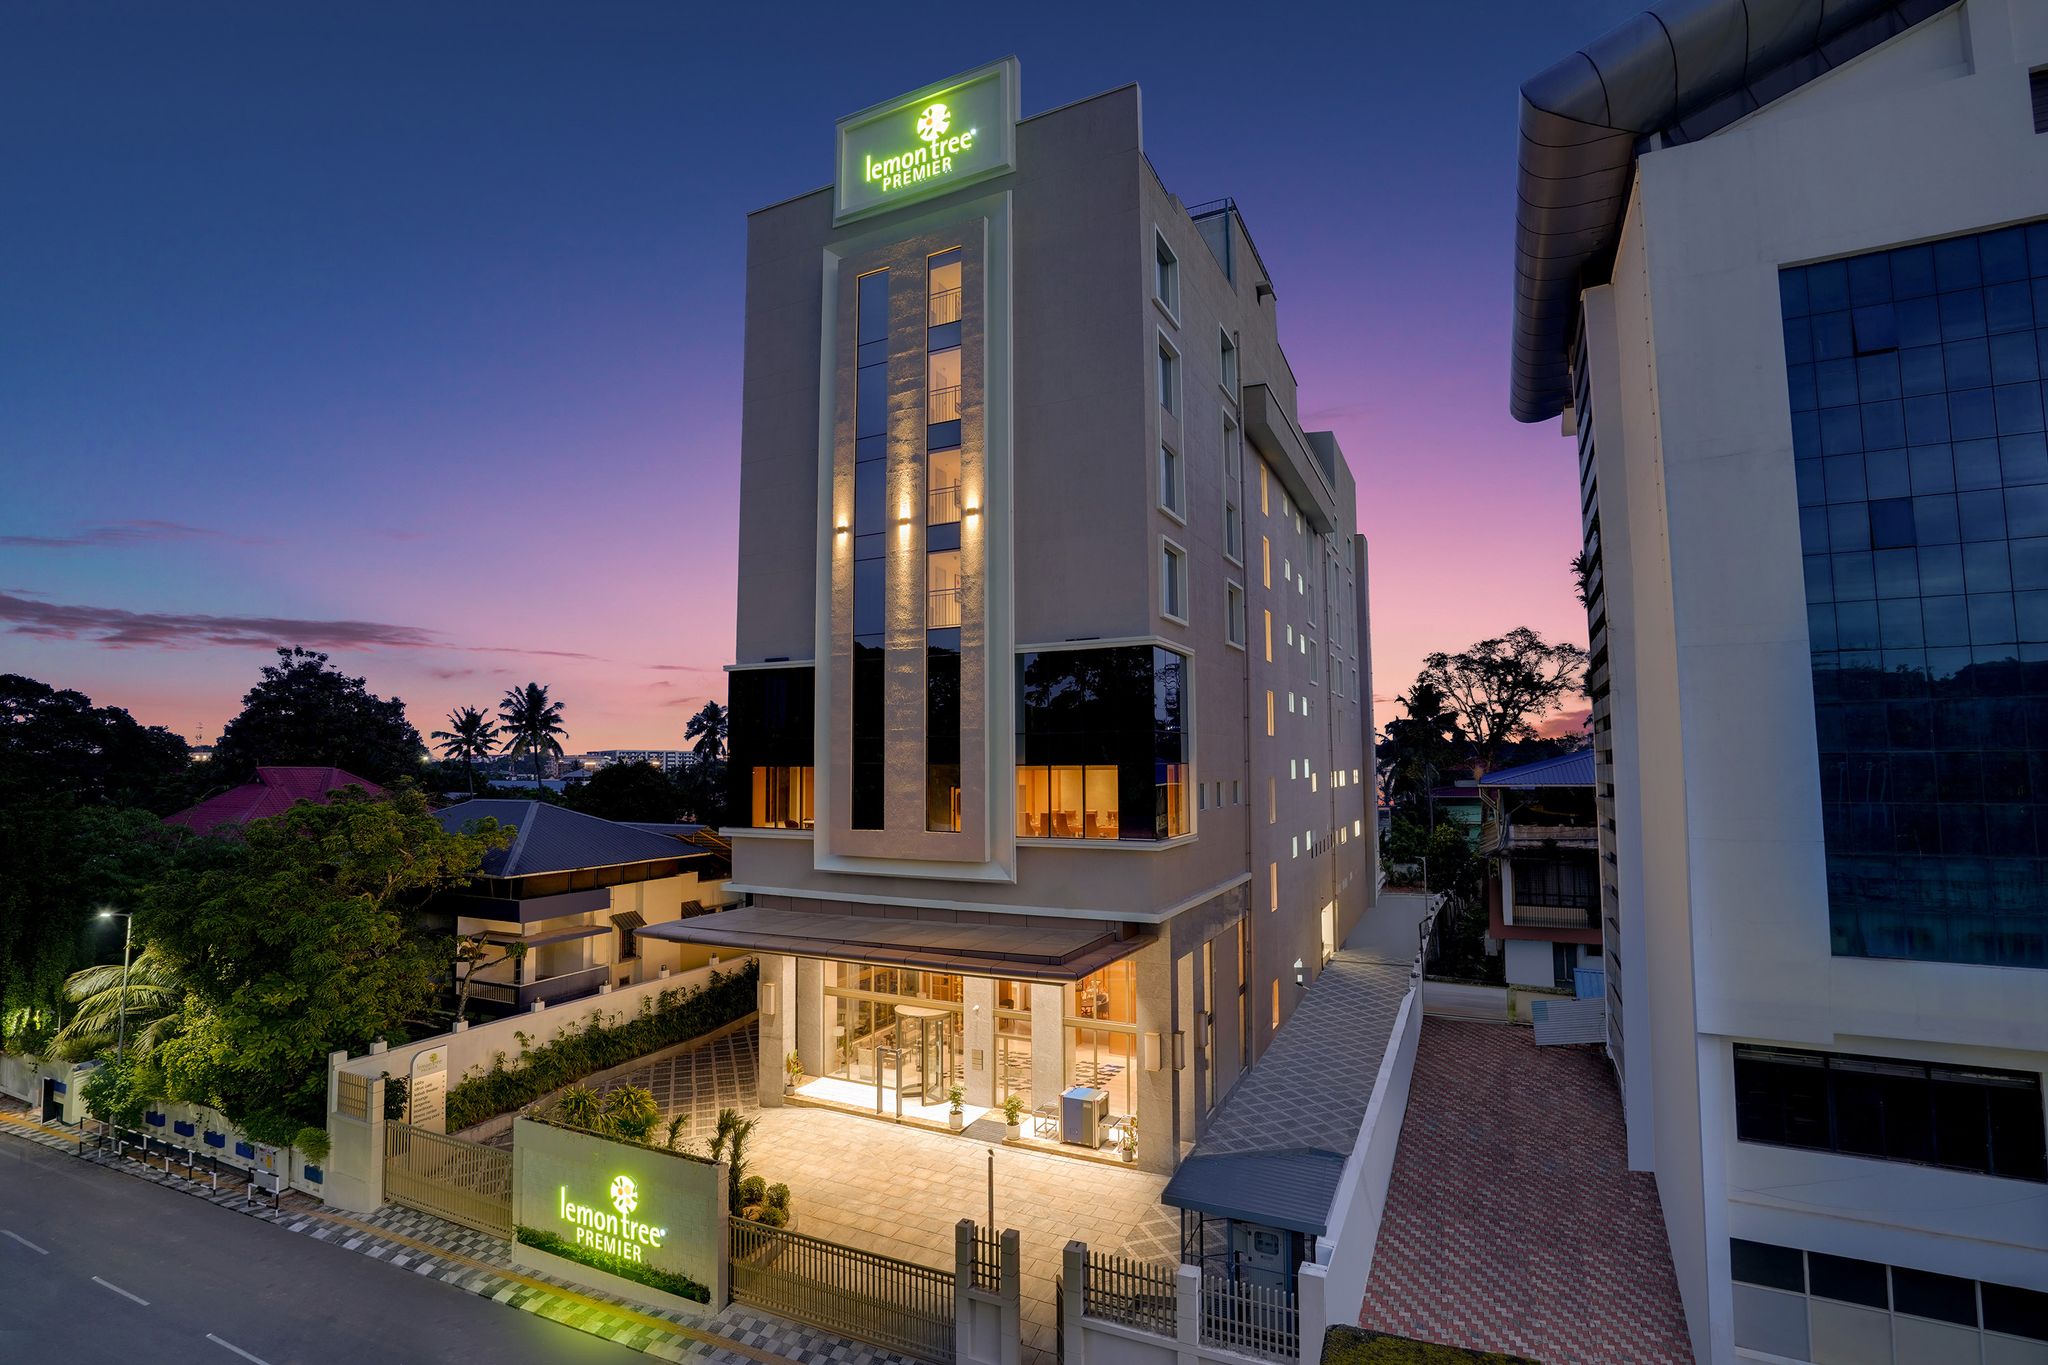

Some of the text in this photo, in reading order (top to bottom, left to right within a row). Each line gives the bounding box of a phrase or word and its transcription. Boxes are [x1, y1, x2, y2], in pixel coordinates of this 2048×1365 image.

[866, 131, 973, 182] lemon tree
[882, 156, 952, 192] PREMIER
[560, 1186, 661, 1247] lemon tree
[576, 1227, 642, 1263] PREMIER
